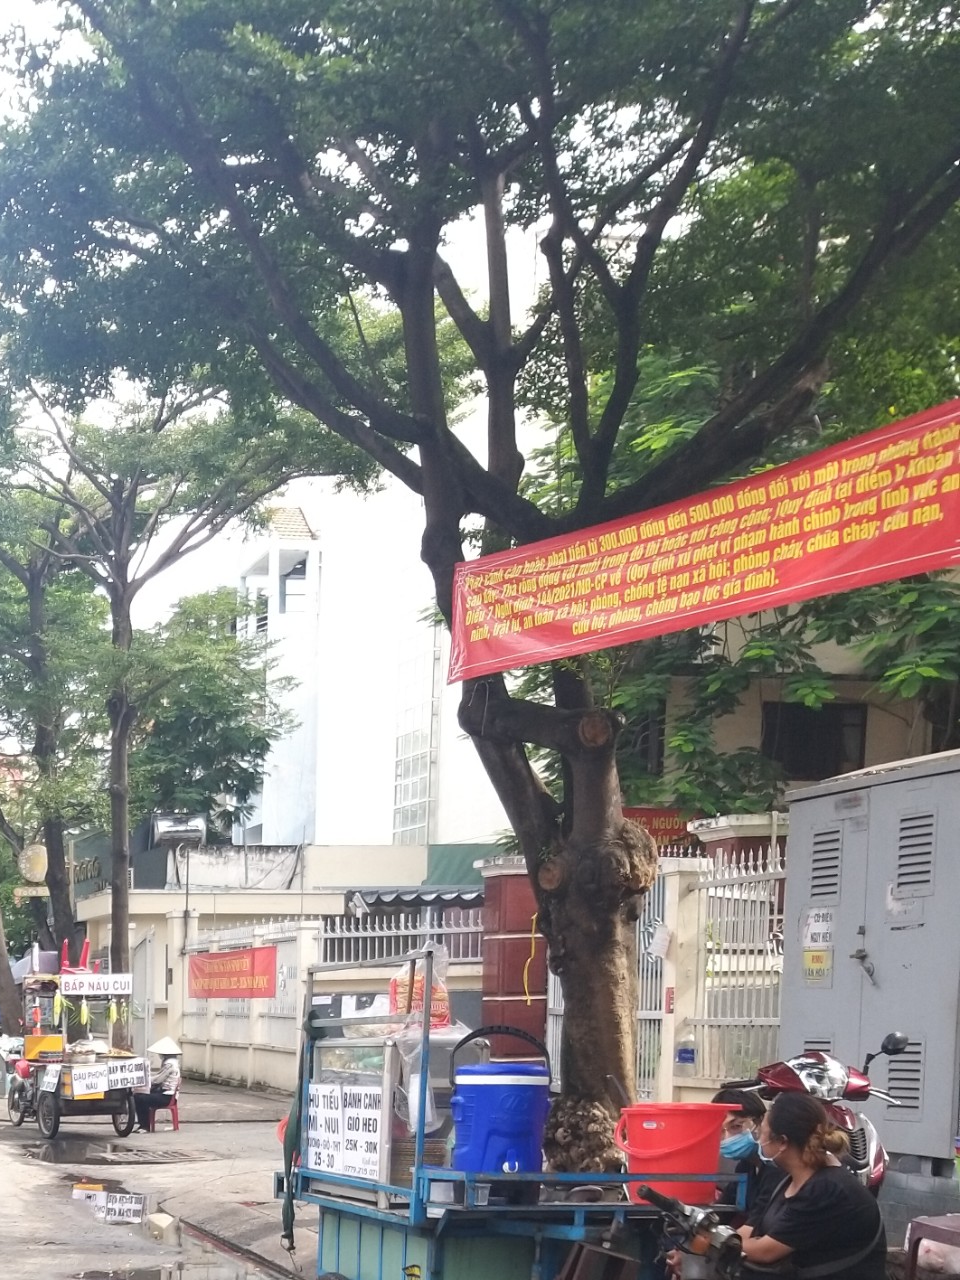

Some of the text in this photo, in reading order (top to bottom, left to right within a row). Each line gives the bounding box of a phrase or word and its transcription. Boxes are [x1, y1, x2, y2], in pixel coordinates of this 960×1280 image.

[568, 541, 587, 562] tiền
[588, 538, 598, 556] từ
[599, 525, 638, 552] 300.000
[640, 518, 666, 540] đồng
[667, 508, 688, 531] đến
[689, 494, 735, 524] 500.000
[736, 486, 767, 510] đồng
[768, 475, 789, 500] đối
[791, 470, 810, 492] với
[813, 461, 839, 486] một
[841, 452, 876, 477] trong
[660, 532, 689, 553] hoặc
[689, 524, 710, 545] nơi
[709, 518, 739, 538] công
[835, 478, 853, 502] tại
[855, 465, 892, 494] điểm
[609, 564, 624, 586] về
[651, 553, 675, 577] định
[676, 546, 692, 567] xử
[693, 540, 718, 565] phạt
[720, 536, 732, 554] vi
[733, 528, 767, 554] phạm
[769, 516, 800, 541] hành
[803, 506, 841, 532] chính
[842, 496, 878, 521] trong
[881, 485, 910, 510] lĩnh
[941, 472, 960, 494] an
[523, 615, 534, 630] an
[534, 609, 555, 626] toàn
[589, 591, 622, 614] phòng,
[624, 578, 655, 603] chống
[656, 575, 667, 597] tệ
[670, 571, 690, 593] nạn
[692, 564, 707, 585] xã
[733, 549, 770, 576] phòng
[806, 529, 840, 553] chữa
[882, 509, 909, 533] cứu
[912, 503, 944, 527] nạn,
[572, 616, 590, 636] cứu
[679, 590, 701, 611] bạo
[702, 585, 721, 605] lực
[722, 579, 742, 600] gia
[744, 567, 780, 592] đình).
[321, 1088, 339, 1111] TIẾU
[363, 1093, 382, 1111] CANH
[324, 1116, 339, 1135] NUI
[362, 1117, 378, 1133] HEO
[344, 1138, 378, 1155] 25K 30K
[314, 1151, 335, 1168] 25 30
